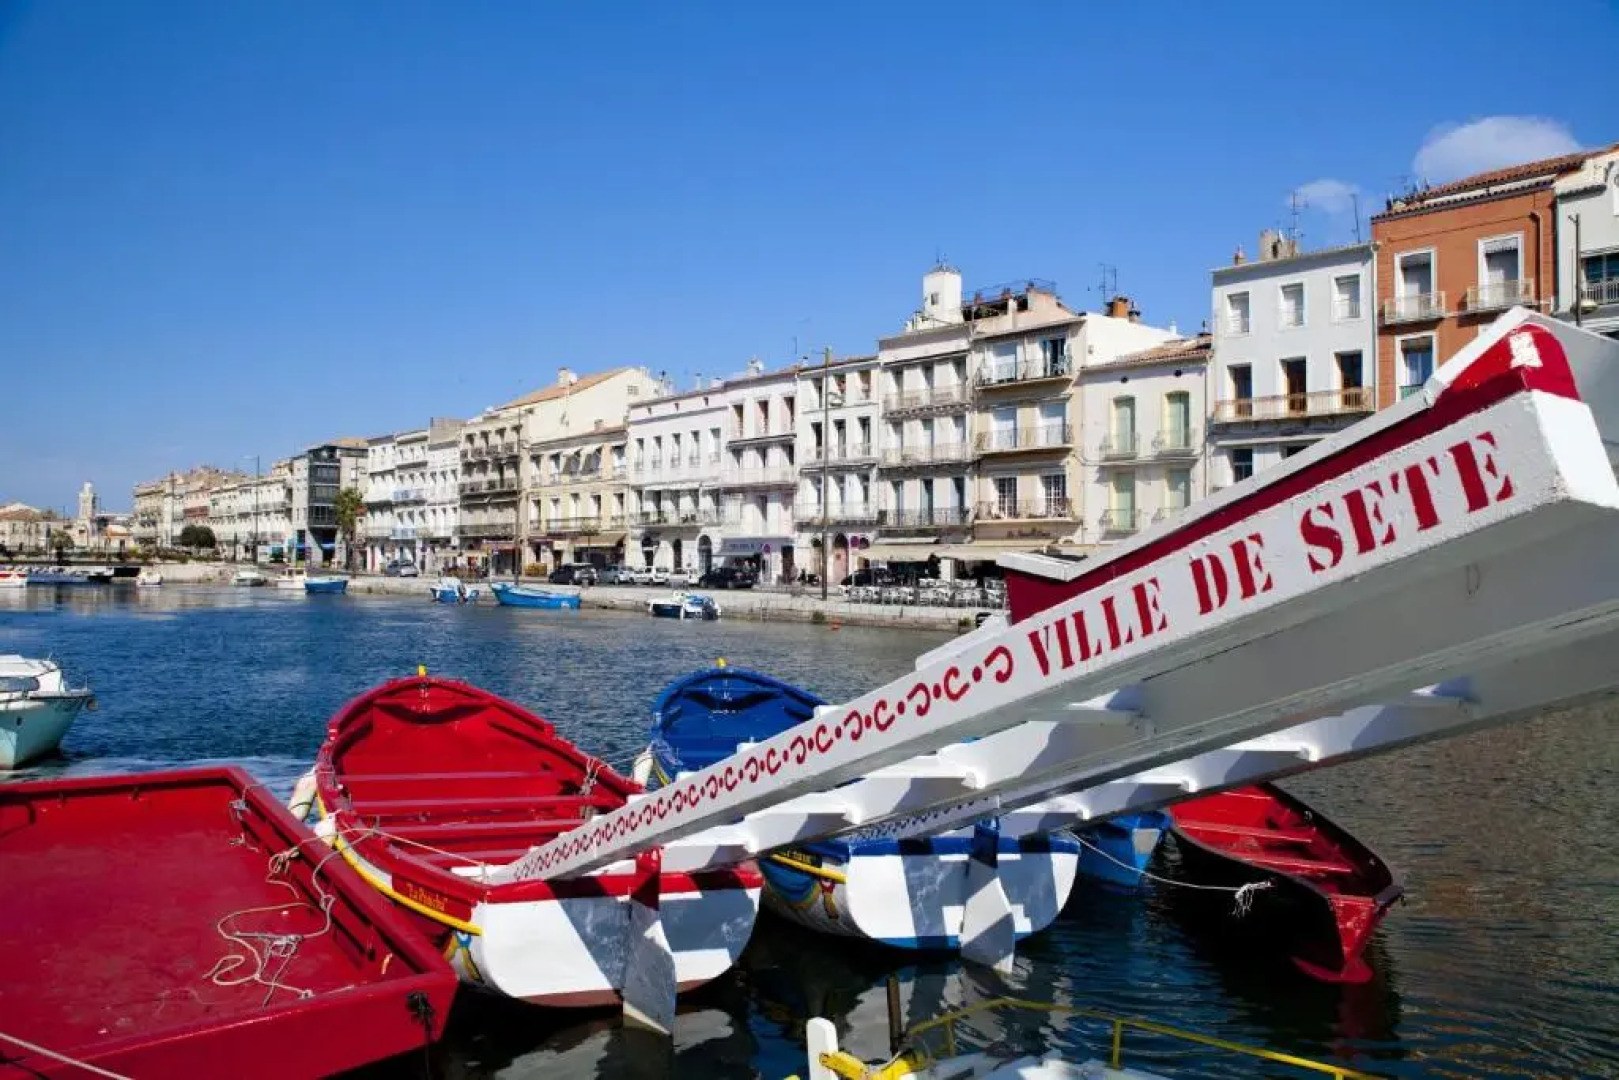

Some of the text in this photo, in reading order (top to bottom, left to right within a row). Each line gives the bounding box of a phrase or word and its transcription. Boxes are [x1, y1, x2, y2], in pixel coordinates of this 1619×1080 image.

[1028, 431, 1514, 677] VILLE DE SETE
